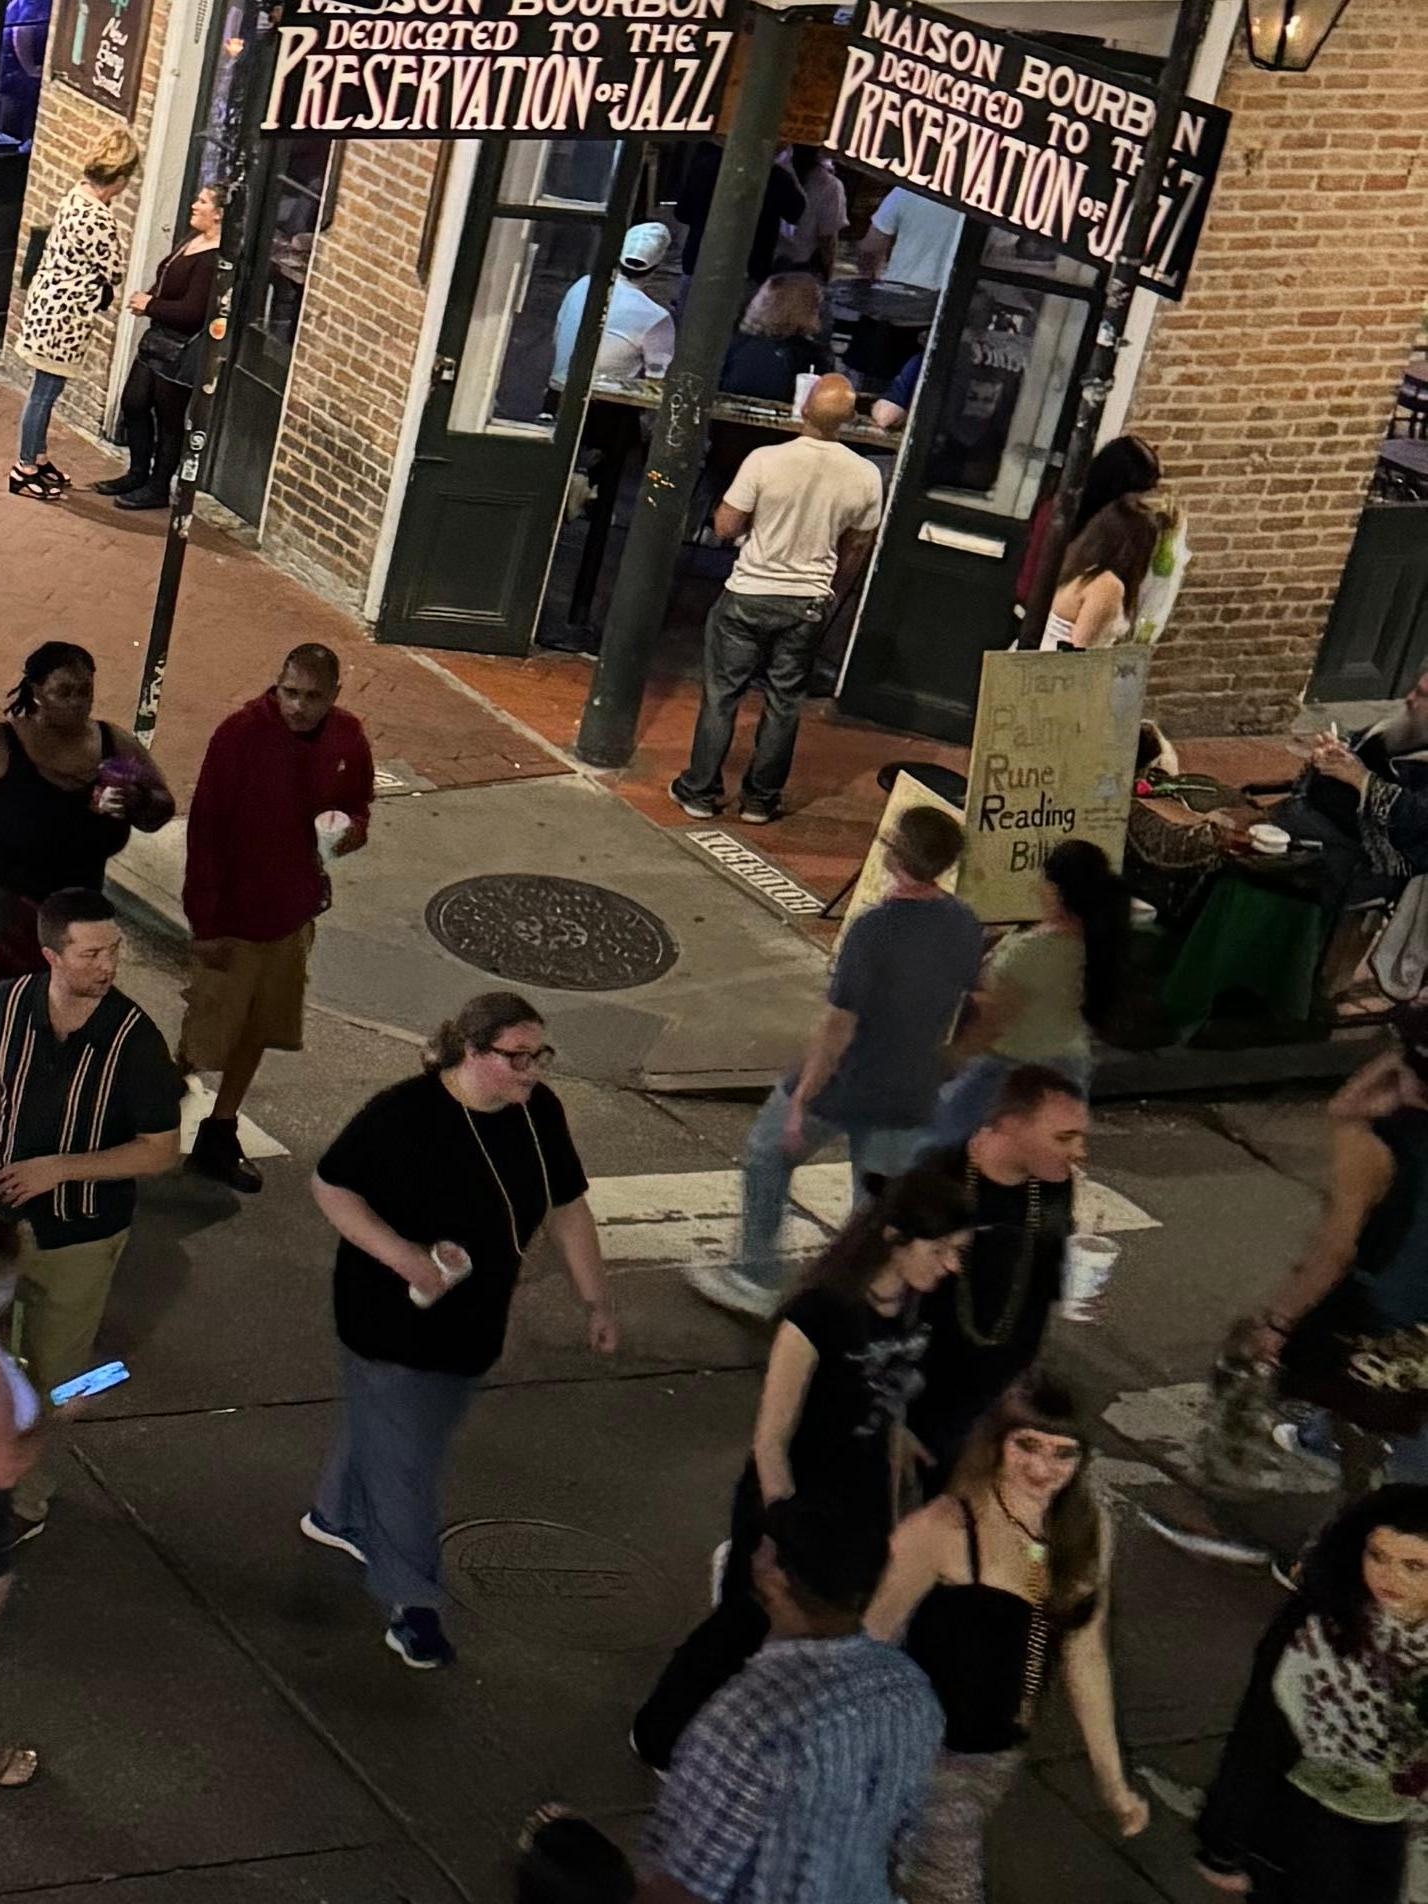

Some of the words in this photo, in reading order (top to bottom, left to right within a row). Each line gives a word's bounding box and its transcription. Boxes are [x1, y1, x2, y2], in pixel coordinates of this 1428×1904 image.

[260, 25, 603, 132] PRESERVATION
[325, 18, 519, 51] DEDICATED
[548, 21, 600, 52] TO
[626, 22, 703, 53] THE
[861, 0, 1006, 83] MAISON
[1016, 54, 1208, 158] BOURBN
[594, 82, 629, 103] OF
[607, 31, 734, 132] JAZZ
[877, 50, 1024, 131] DEDICATED
[1046, 111, 1090, 156] TO
[1111, 137, 1177, 187] TH
[823, 45, 1090, 244] PRESERVATION
[1077, 195, 1106, 222] OF
[978, 791, 1076, 834] Reading
[983, 753, 1056, 794] Rune
[696, 832, 822, 914] BOURBON
